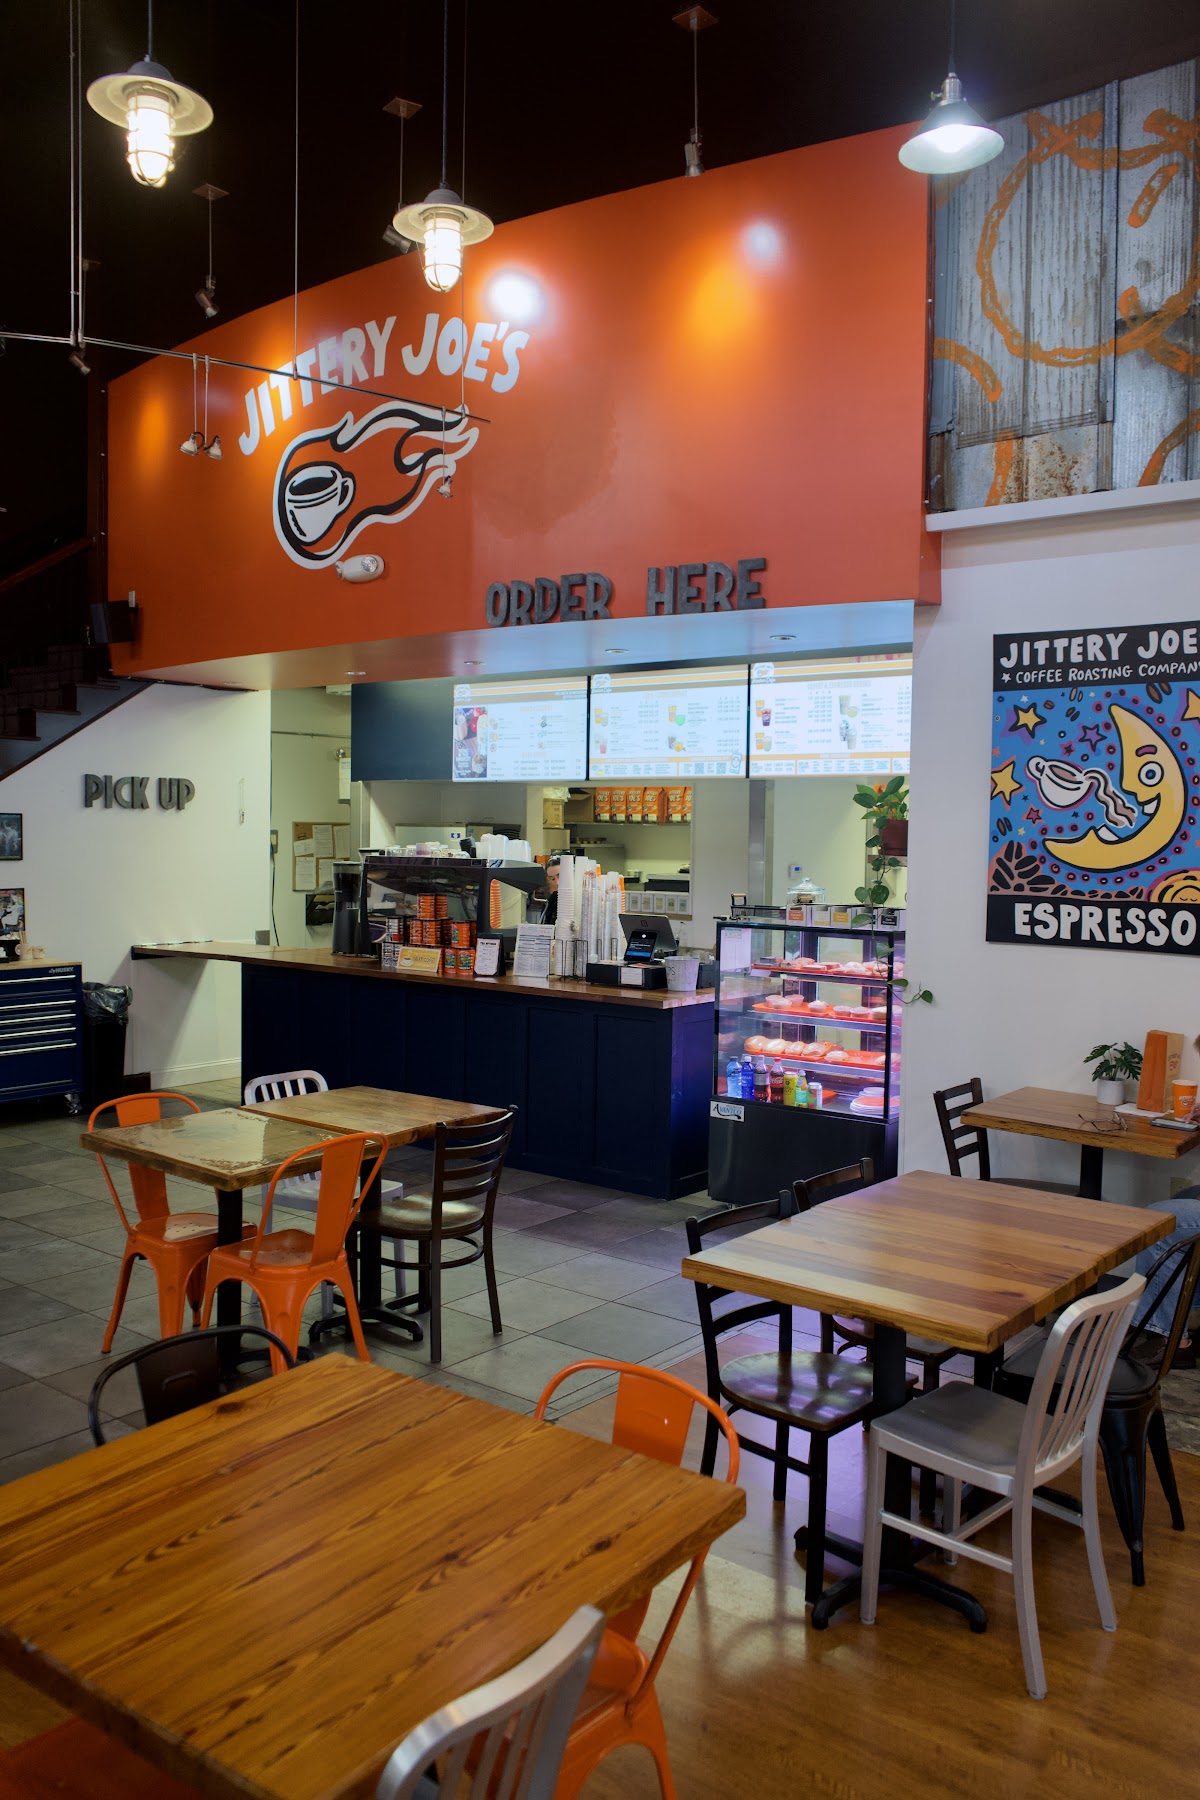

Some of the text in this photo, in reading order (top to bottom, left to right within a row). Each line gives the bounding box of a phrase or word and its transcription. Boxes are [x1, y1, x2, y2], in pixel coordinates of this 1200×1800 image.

[239, 312, 531, 456] JITTERY JOE'S
[485, 557, 768, 629] ORDER HERE
[1000, 627, 1200, 669] JITTERY JOE
[1016, 669, 1062, 684] COFFEE
[1068, 665, 1132, 681] ROASTING
[84, 773, 196, 810] PICK UP
[1014, 902, 1196, 946] ESPRESSO
[55, 966, 74, 974] HUSKY
